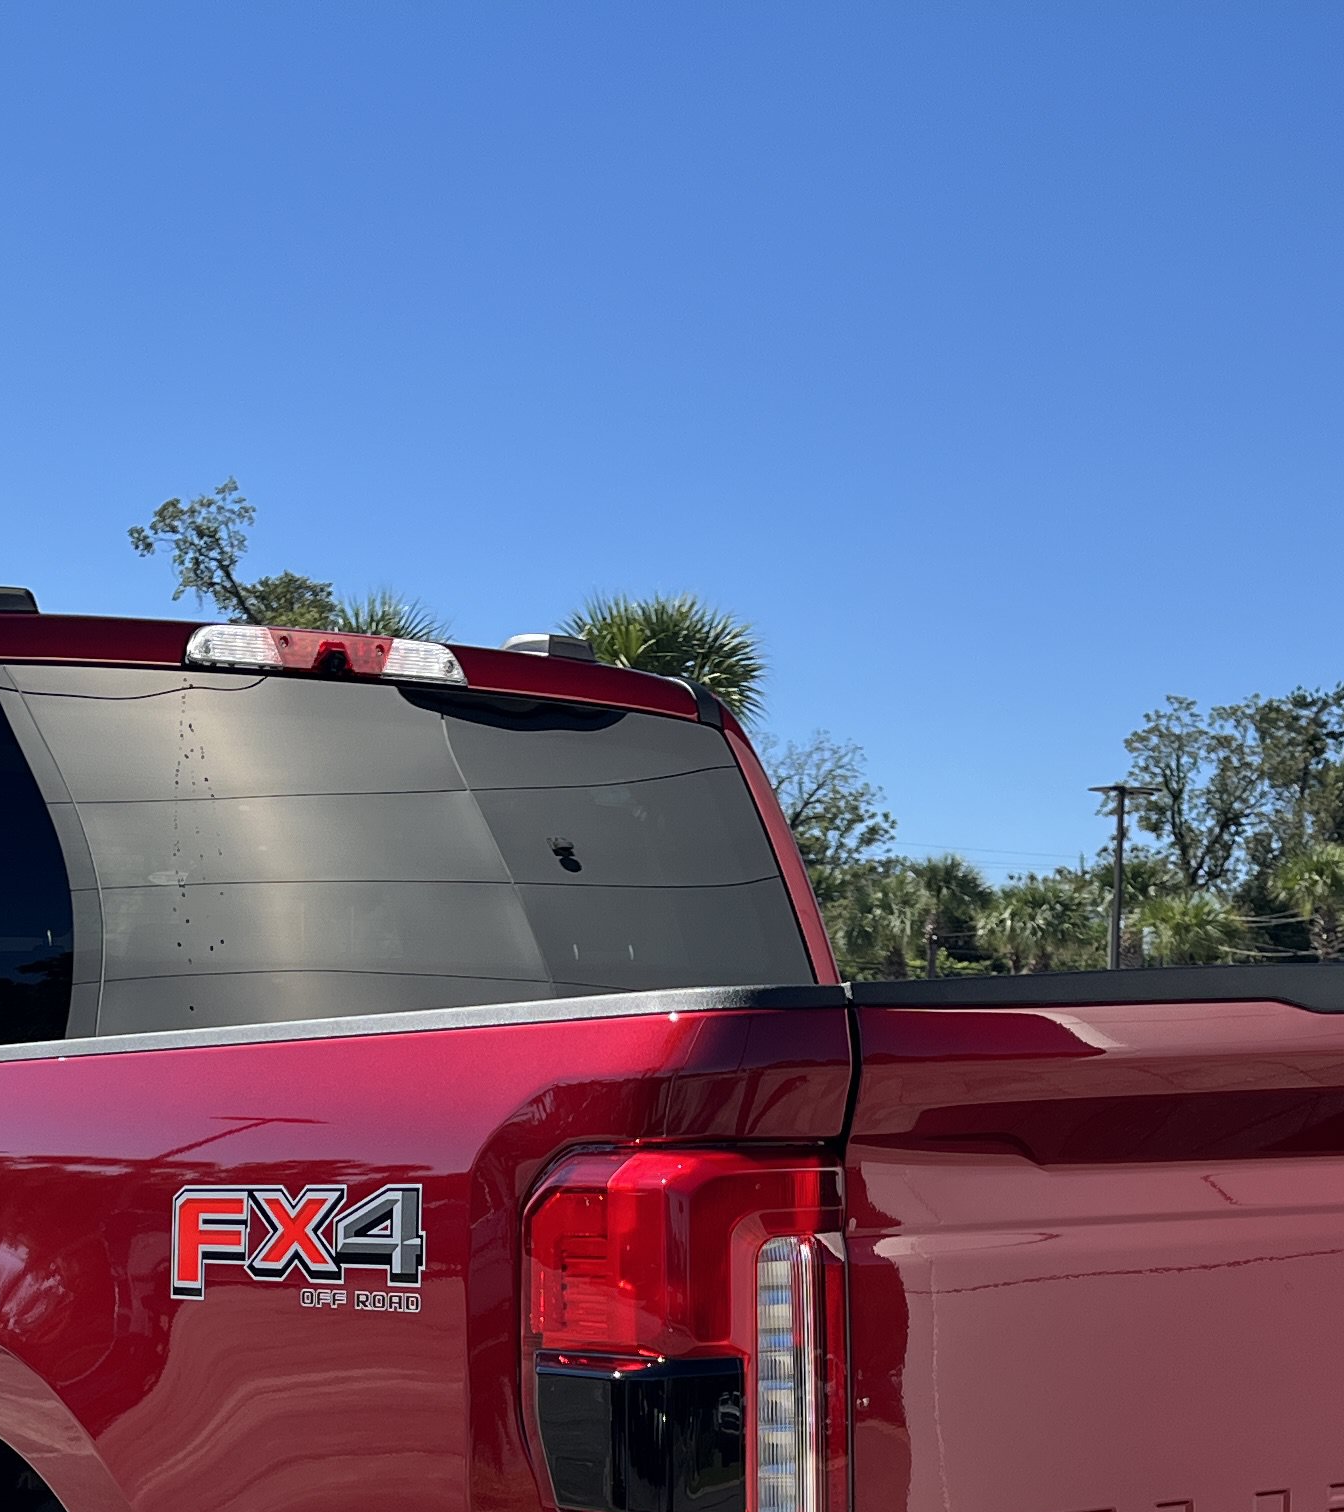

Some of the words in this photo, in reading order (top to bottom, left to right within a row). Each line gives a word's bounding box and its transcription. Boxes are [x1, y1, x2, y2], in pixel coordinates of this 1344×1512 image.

[170, 1184, 426, 1300] FX4
[300, 1288, 346, 1308] OFF
[354, 1291, 421, 1313] ROAD
